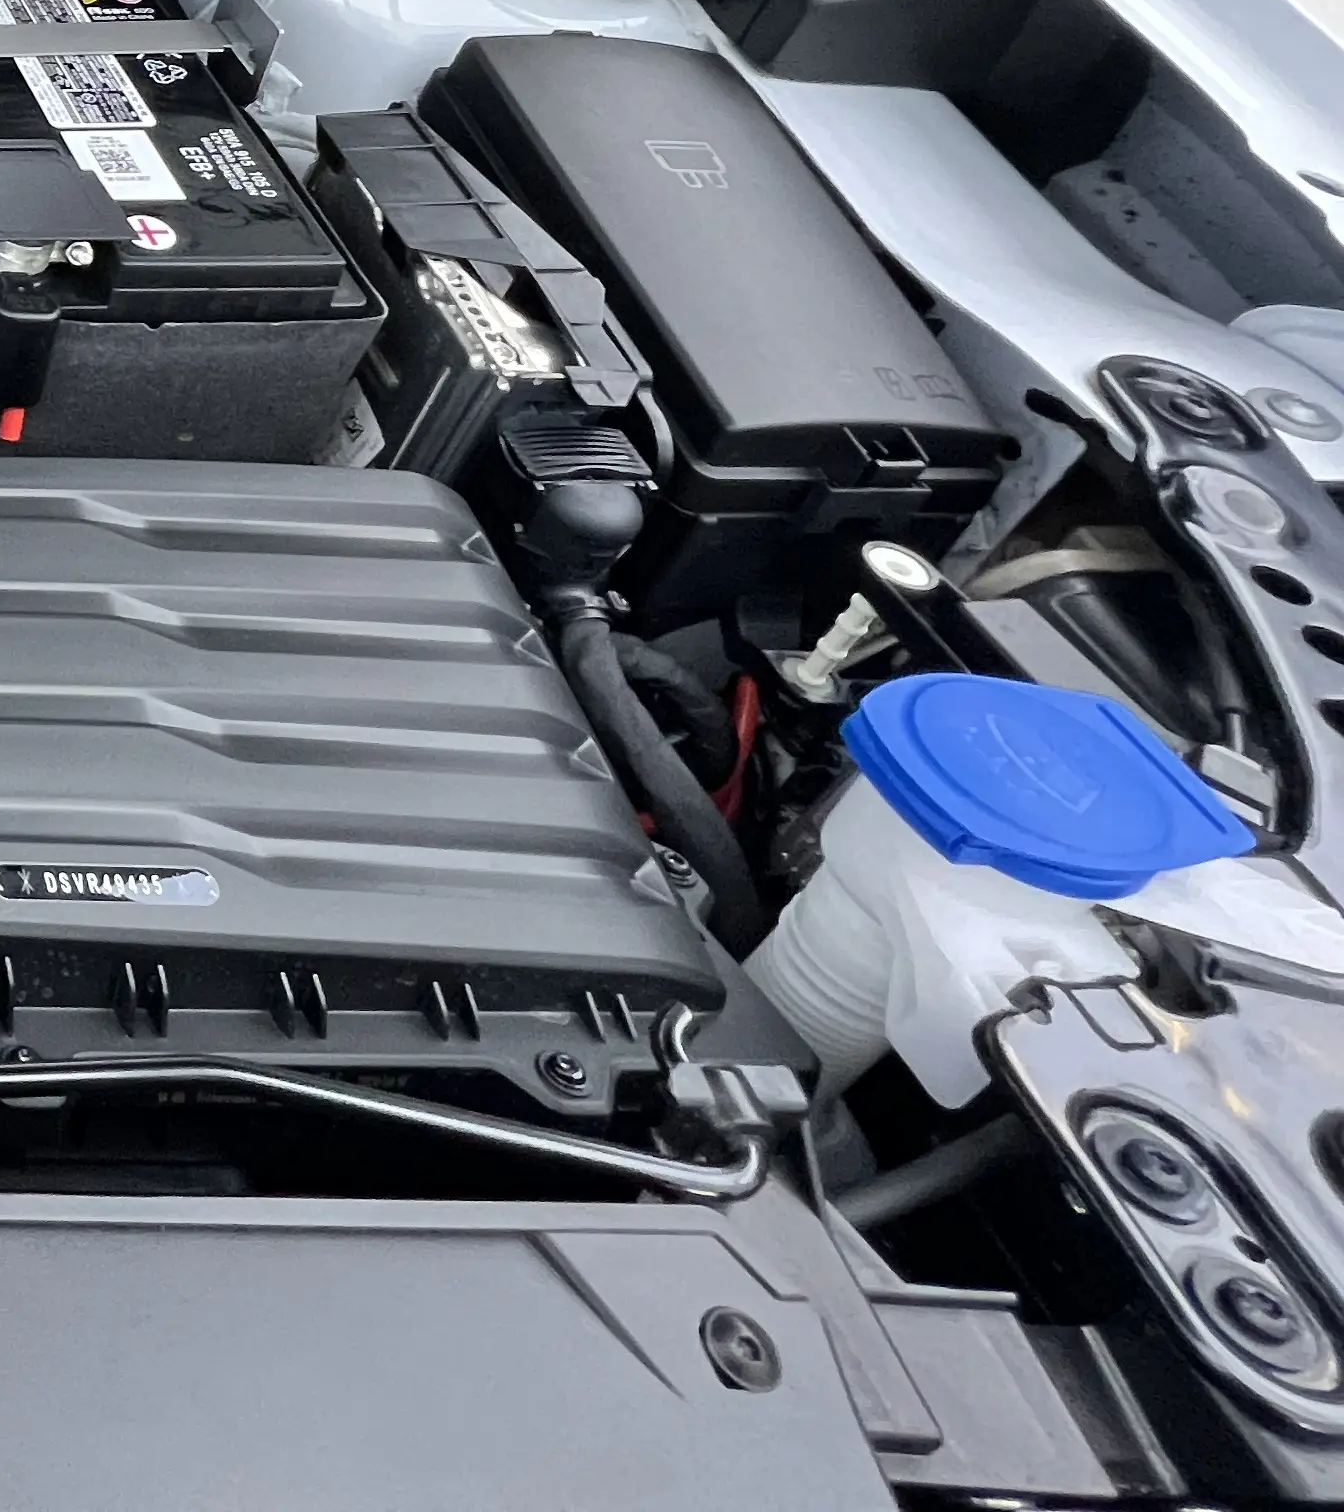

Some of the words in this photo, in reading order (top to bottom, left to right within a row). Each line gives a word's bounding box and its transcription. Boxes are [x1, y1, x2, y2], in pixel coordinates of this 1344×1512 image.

[178, 146, 217, 181] EFB+
[218, 129, 244, 148] 5WA
[233, 150, 256, 167] 915
[247, 171, 271, 187] 105
